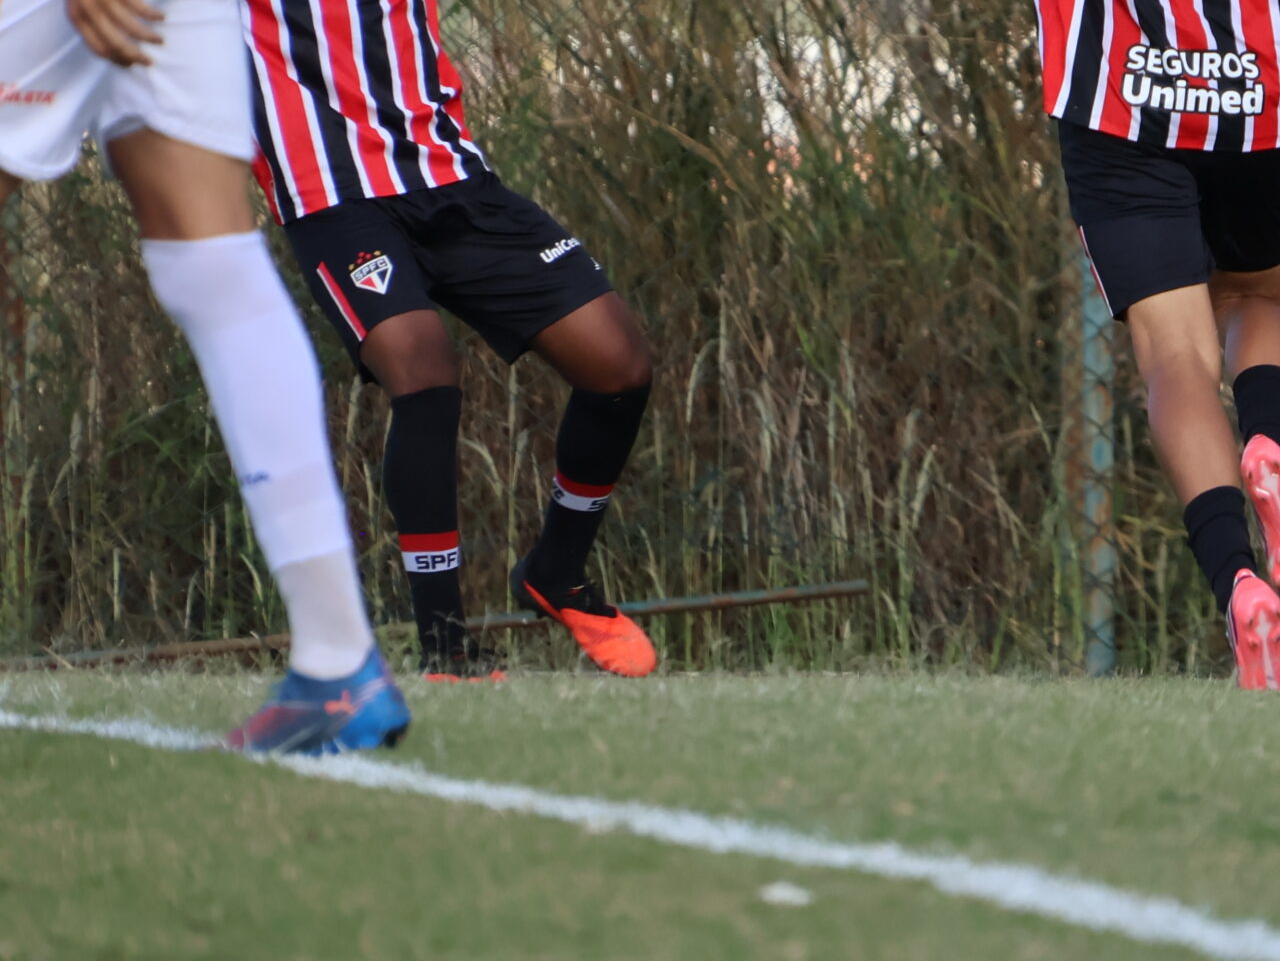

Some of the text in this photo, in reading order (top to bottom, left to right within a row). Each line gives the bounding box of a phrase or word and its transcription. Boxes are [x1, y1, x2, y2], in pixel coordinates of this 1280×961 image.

[1126, 45, 1260, 79] SEGUROS
[1121, 73, 1265, 115] Unimed
[353, 258, 388, 281] SPFC
